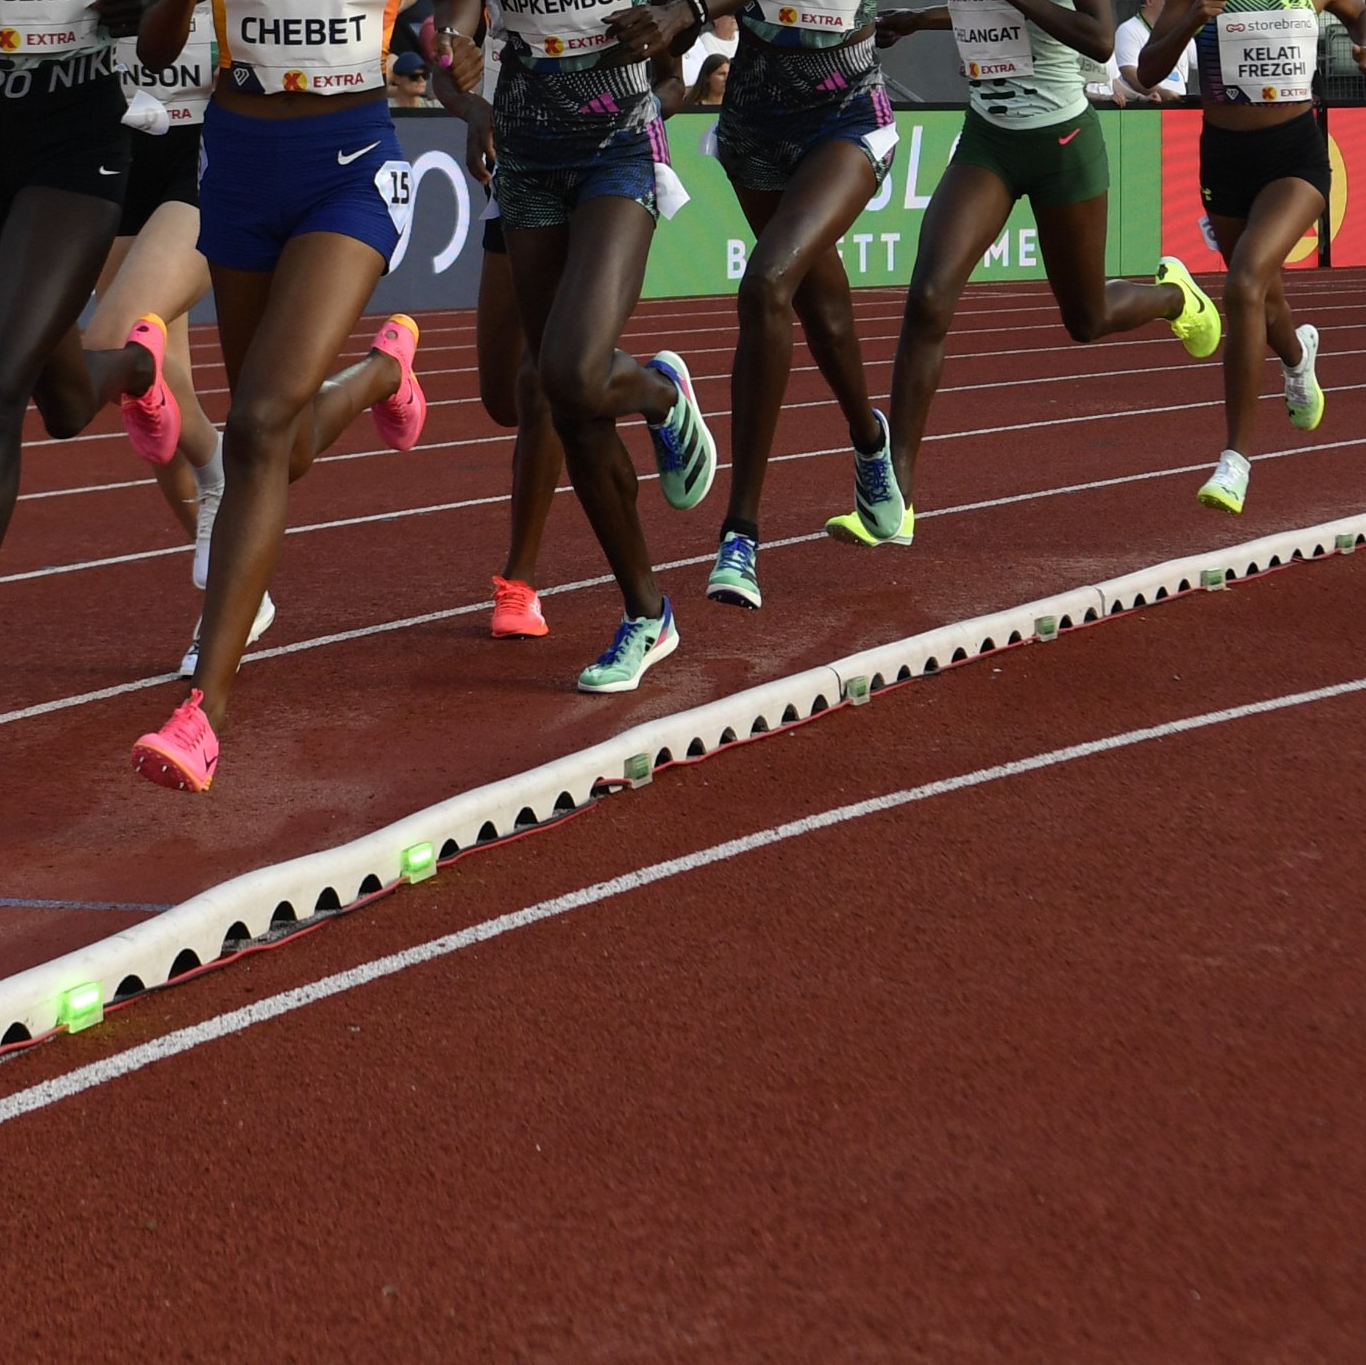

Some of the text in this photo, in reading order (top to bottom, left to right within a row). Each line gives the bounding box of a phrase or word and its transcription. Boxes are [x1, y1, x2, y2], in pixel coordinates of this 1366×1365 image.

[801, 13, 843, 26] EXTRA
[241, 14, 366, 45] CHEBET
[27, 31, 76, 46] EXTRA
[568, 34, 616, 49] EXTRA
[1243, 46, 1301, 61] KELATI
[48, 47, 111, 93] NIK
[122, 64, 200, 87] NSON
[981, 63, 1016, 74] EXTRA
[1238, 62, 1306, 78] FREZGHI
[313, 73, 364, 88] EXTRA
[170, 108, 192, 119] TRA
[390, 171, 410, 204] 15
